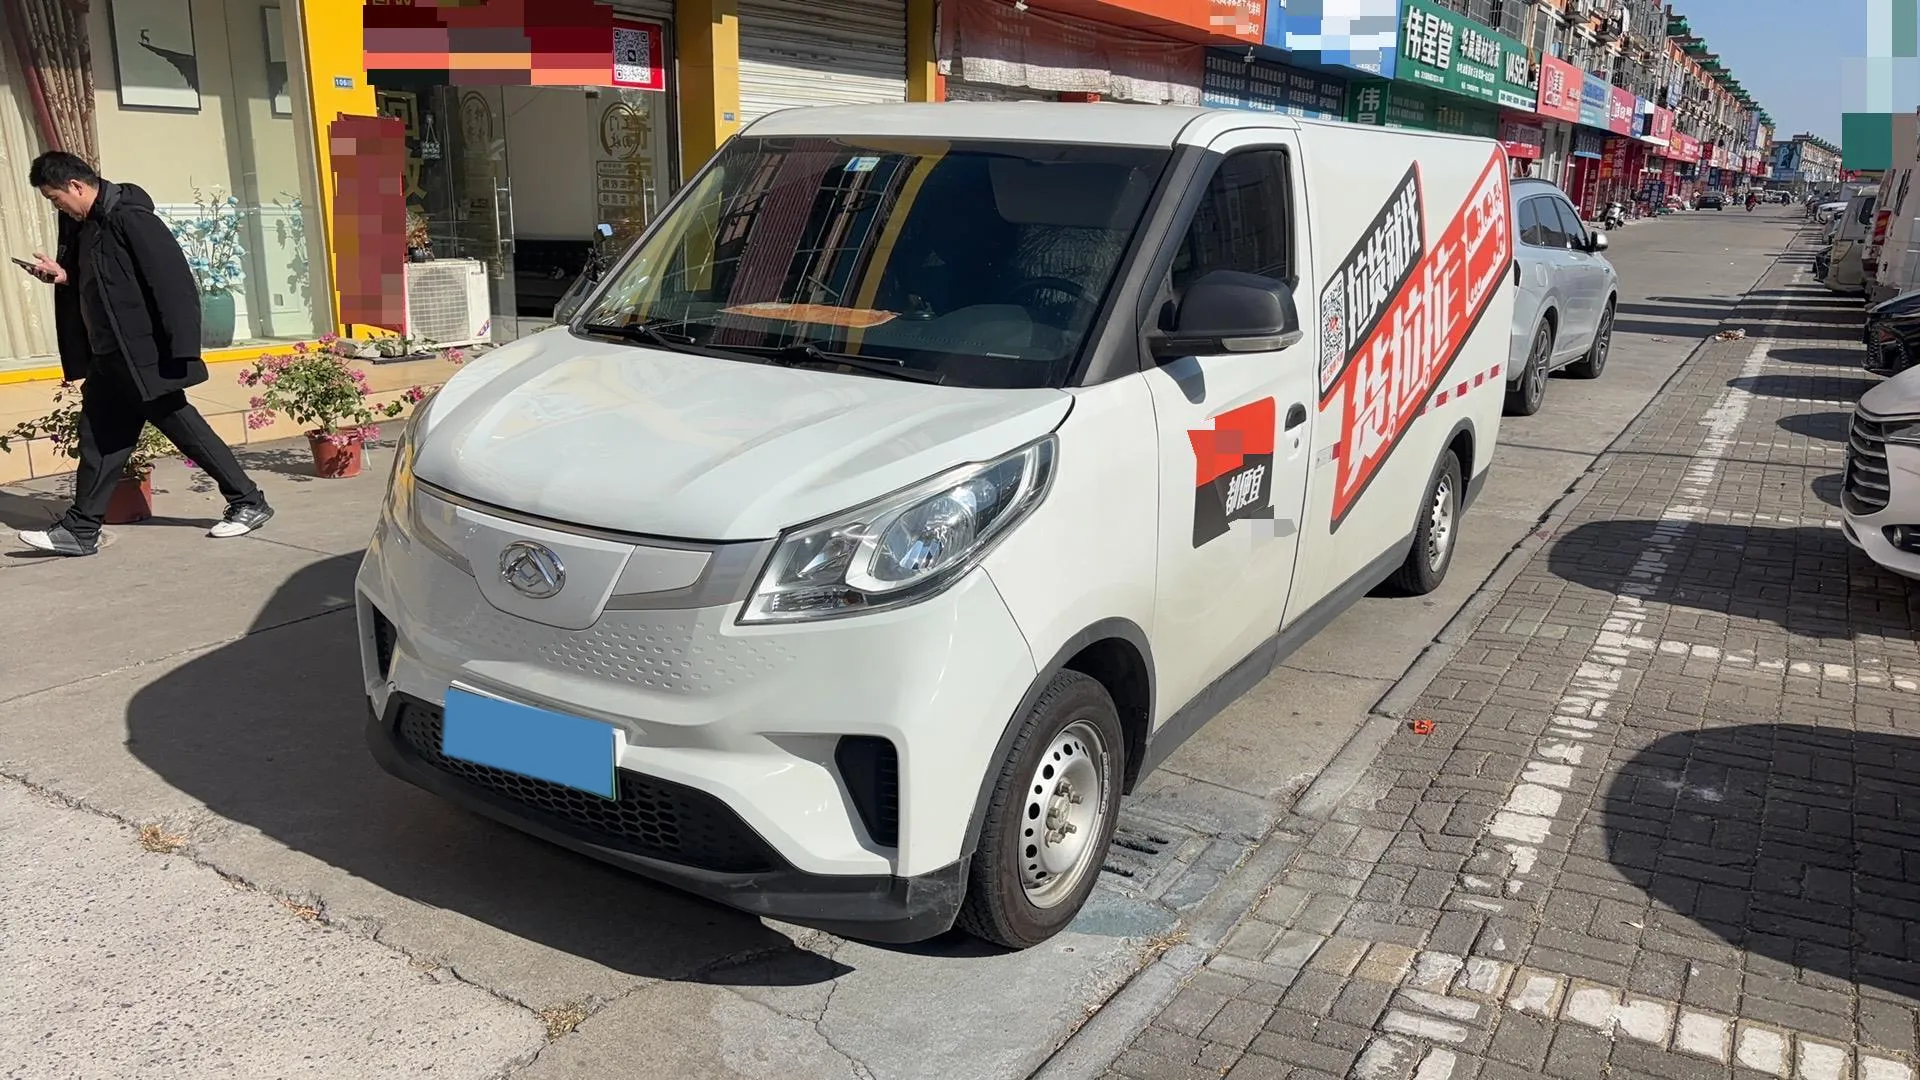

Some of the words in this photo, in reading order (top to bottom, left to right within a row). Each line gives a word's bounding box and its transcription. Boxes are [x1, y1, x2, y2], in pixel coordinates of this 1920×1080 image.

[1405, 4, 1454, 69] 伟星管
[1505, 51, 1530, 87] VASEN
[1347, 177, 1422, 350] 拉货就找
[1343, 248, 1458, 497] 货拉拉
[1225, 464, 1265, 516] 都便宜
